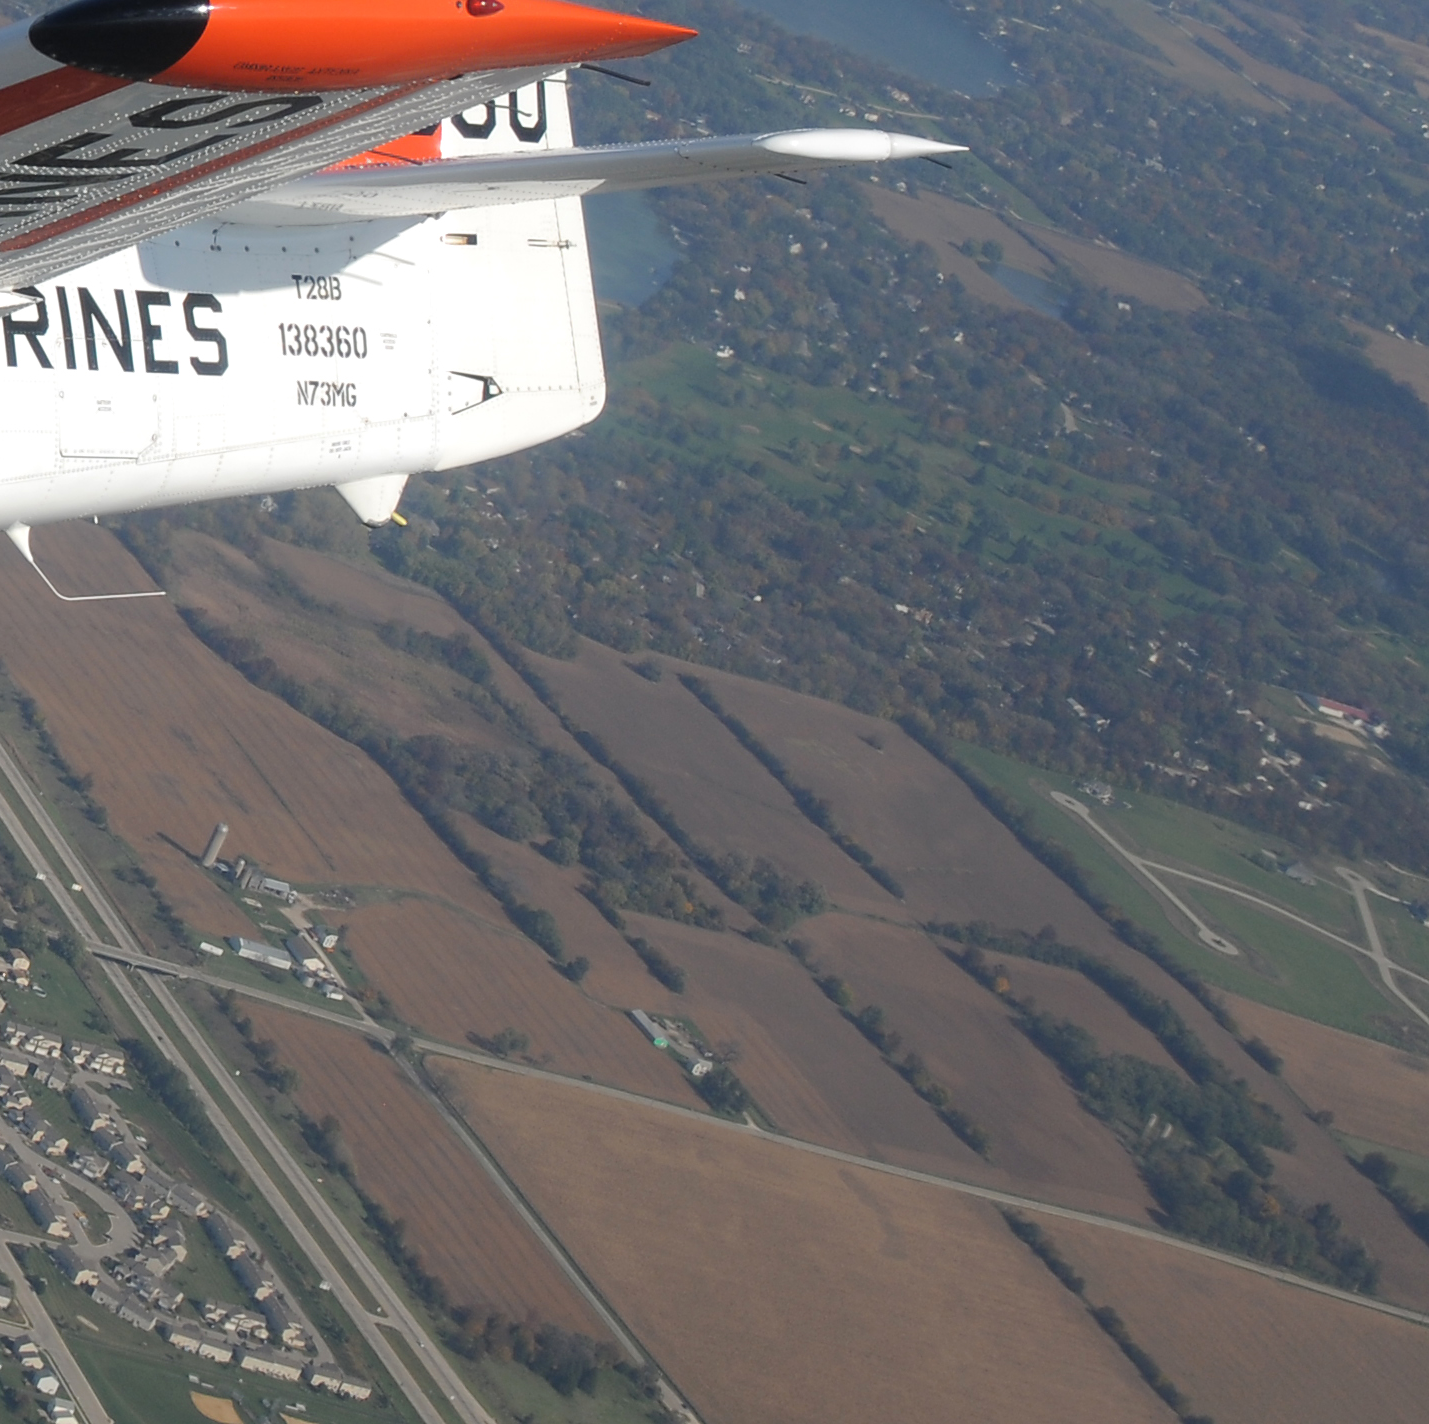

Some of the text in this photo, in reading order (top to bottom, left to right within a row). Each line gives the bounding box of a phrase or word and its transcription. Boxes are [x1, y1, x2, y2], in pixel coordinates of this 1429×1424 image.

[291, 274, 342, 301] T28B
[278, 322, 368, 359] 138360
[296, 380, 357, 407] N73MG
